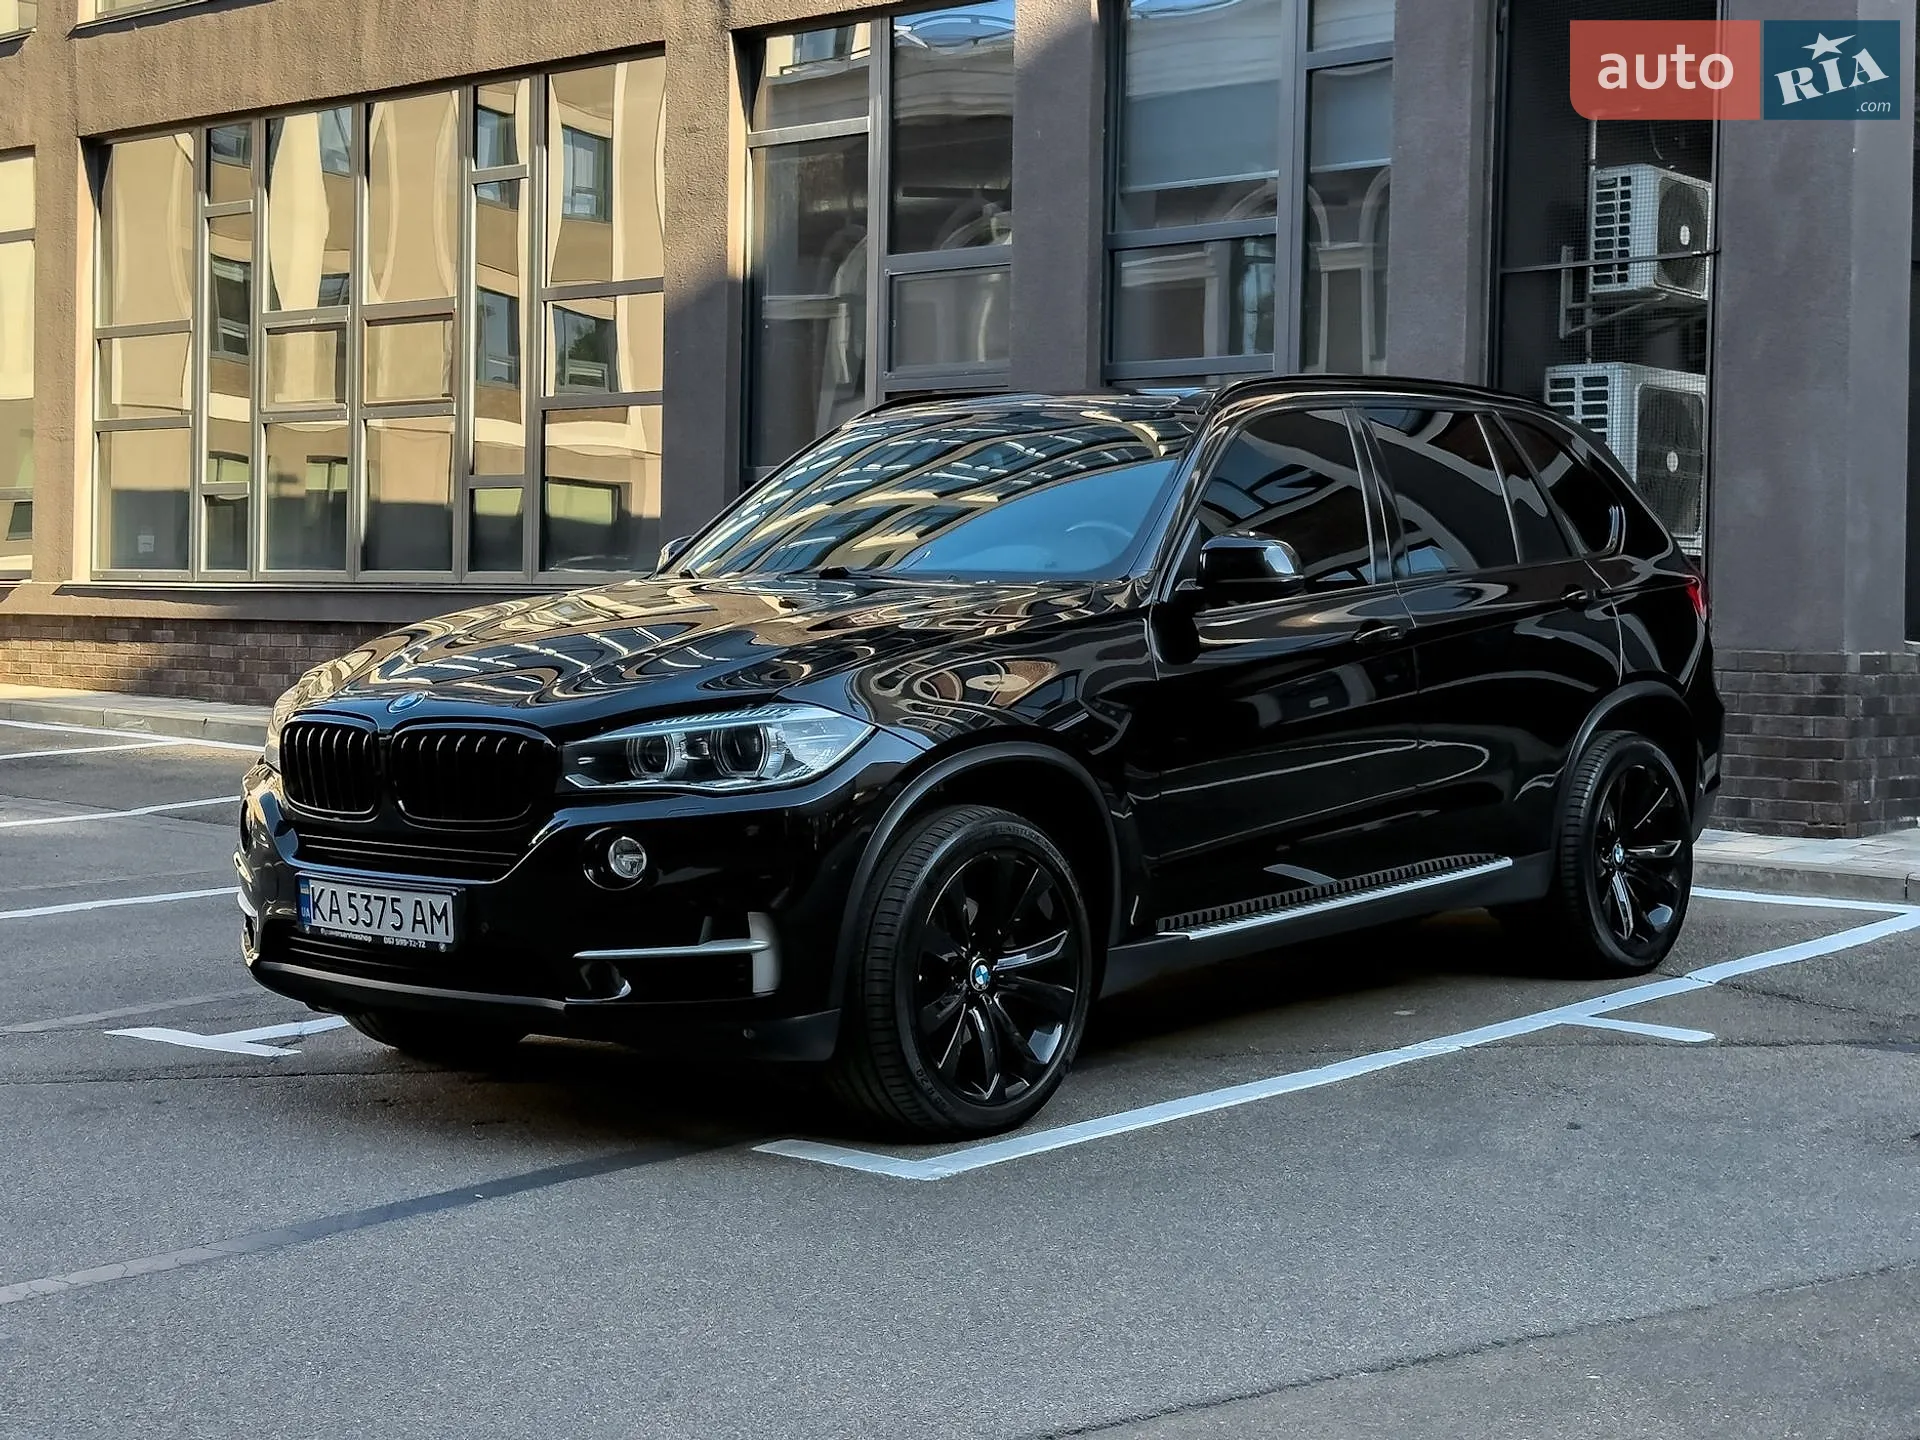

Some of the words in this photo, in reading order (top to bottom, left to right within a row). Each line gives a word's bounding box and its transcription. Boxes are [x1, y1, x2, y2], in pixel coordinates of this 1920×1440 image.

[301, 907, 310, 917] UA
[311, 886, 342, 923] KA
[347, 890, 404, 931] 5375
[411, 898, 450, 937] AM
